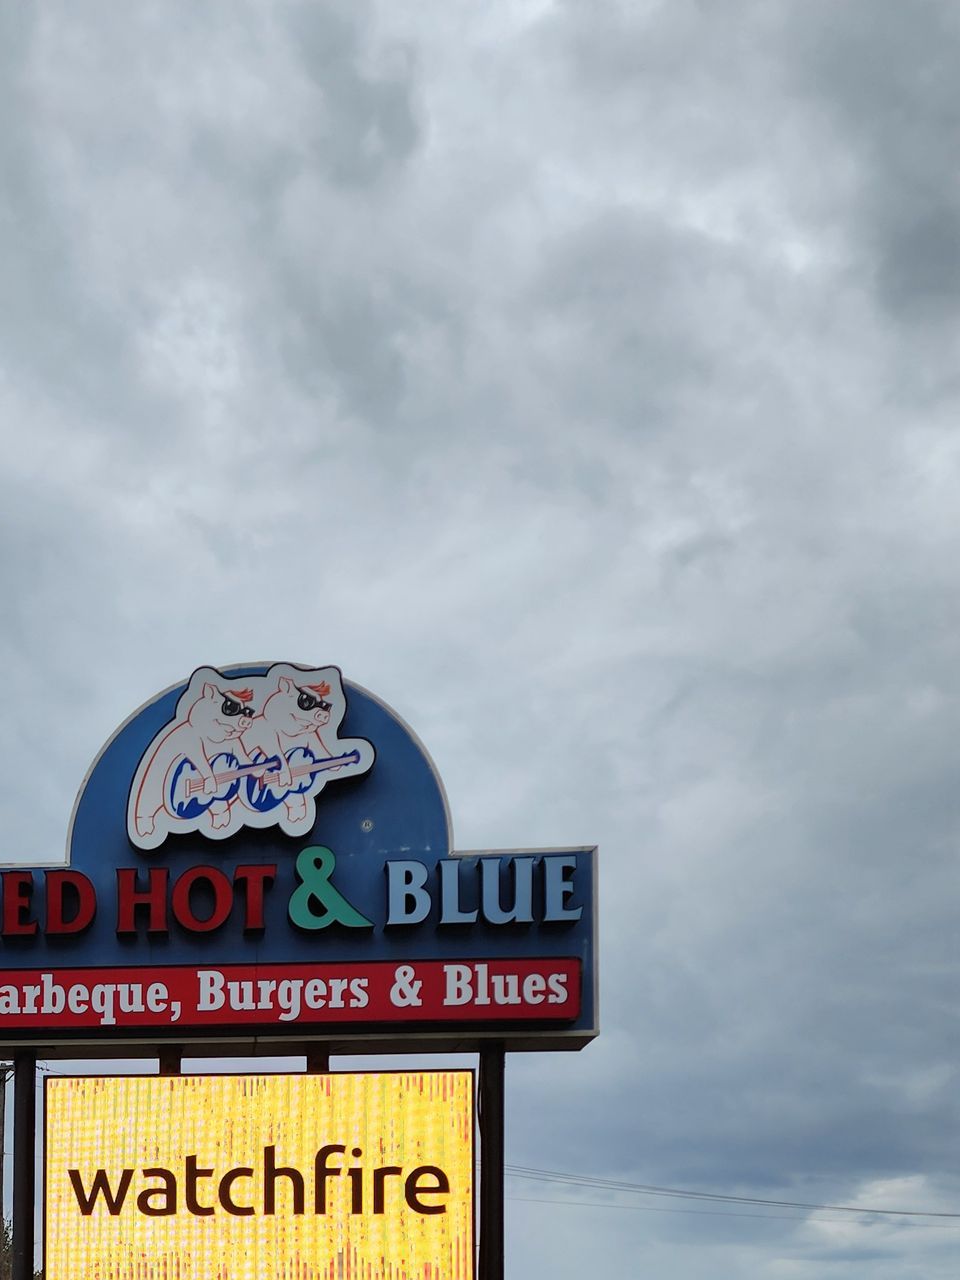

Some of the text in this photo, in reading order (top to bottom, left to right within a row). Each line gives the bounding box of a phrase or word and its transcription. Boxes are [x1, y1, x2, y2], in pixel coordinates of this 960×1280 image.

[116, 863, 277, 933] HOT
[288, 845, 374, 931] &
[385, 855, 584, 925] BLUE
[196, 969, 369, 1021] Burgers
[390, 966, 422, 1007] &
[442, 963, 569, 1006] Blues
[68, 1143, 450, 1216] watchfire
